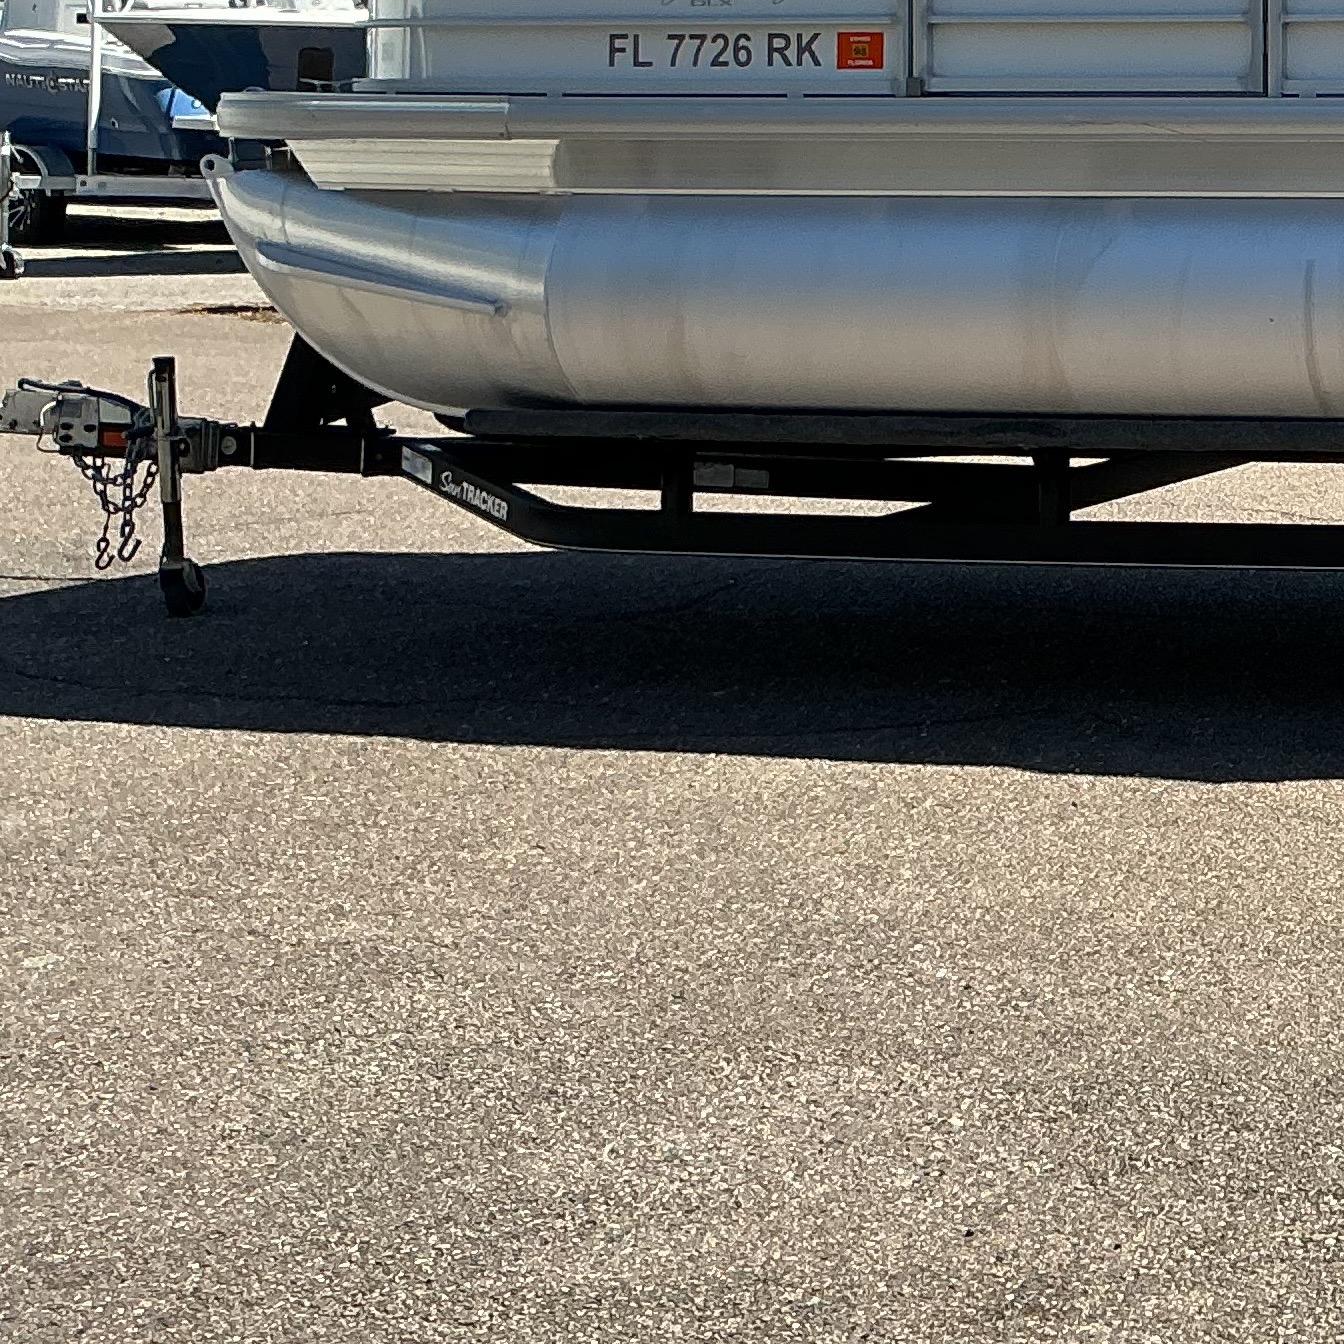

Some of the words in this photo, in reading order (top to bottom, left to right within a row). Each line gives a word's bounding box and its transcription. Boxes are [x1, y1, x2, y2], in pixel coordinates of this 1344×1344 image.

[608, 33, 653, 67] FL
[666, 33, 752, 68] 7726
[767, 32, 822, 67] RK
[440, 471, 462, 497] Sun
[461, 481, 508, 522] TRACKER
